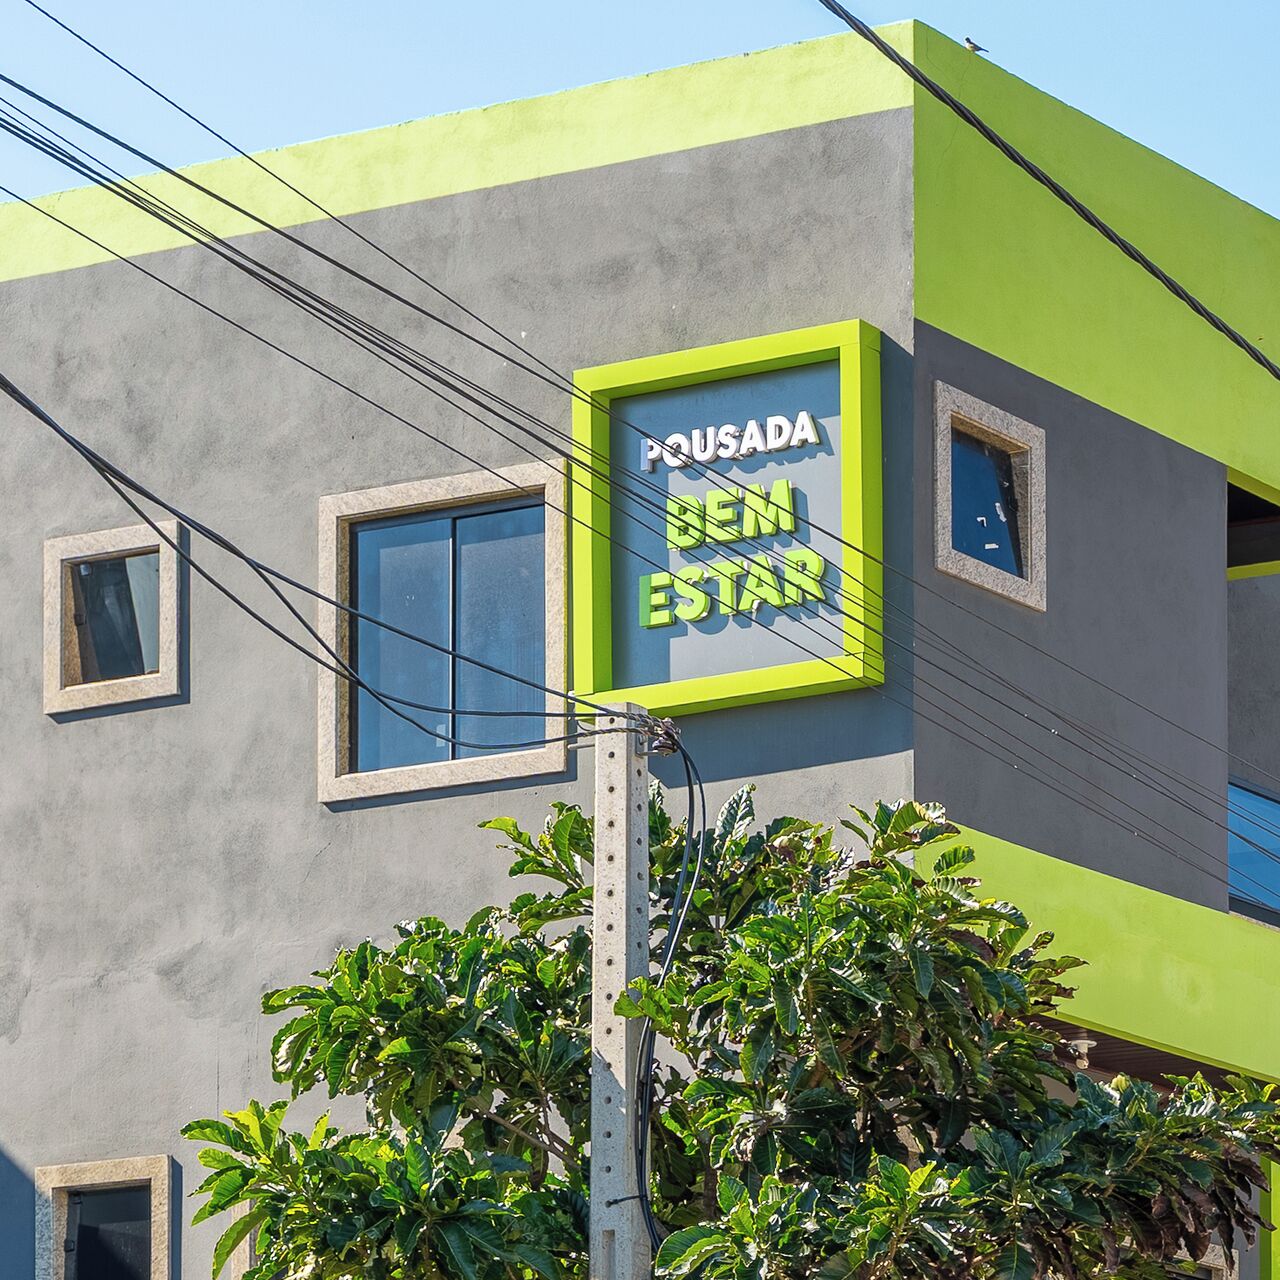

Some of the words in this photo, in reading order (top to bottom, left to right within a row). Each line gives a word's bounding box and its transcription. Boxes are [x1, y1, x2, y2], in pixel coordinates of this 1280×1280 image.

[641, 410, 821, 472] POUSADA
[666, 478, 797, 550] BEM
[640, 549, 826, 628] ESTAR
